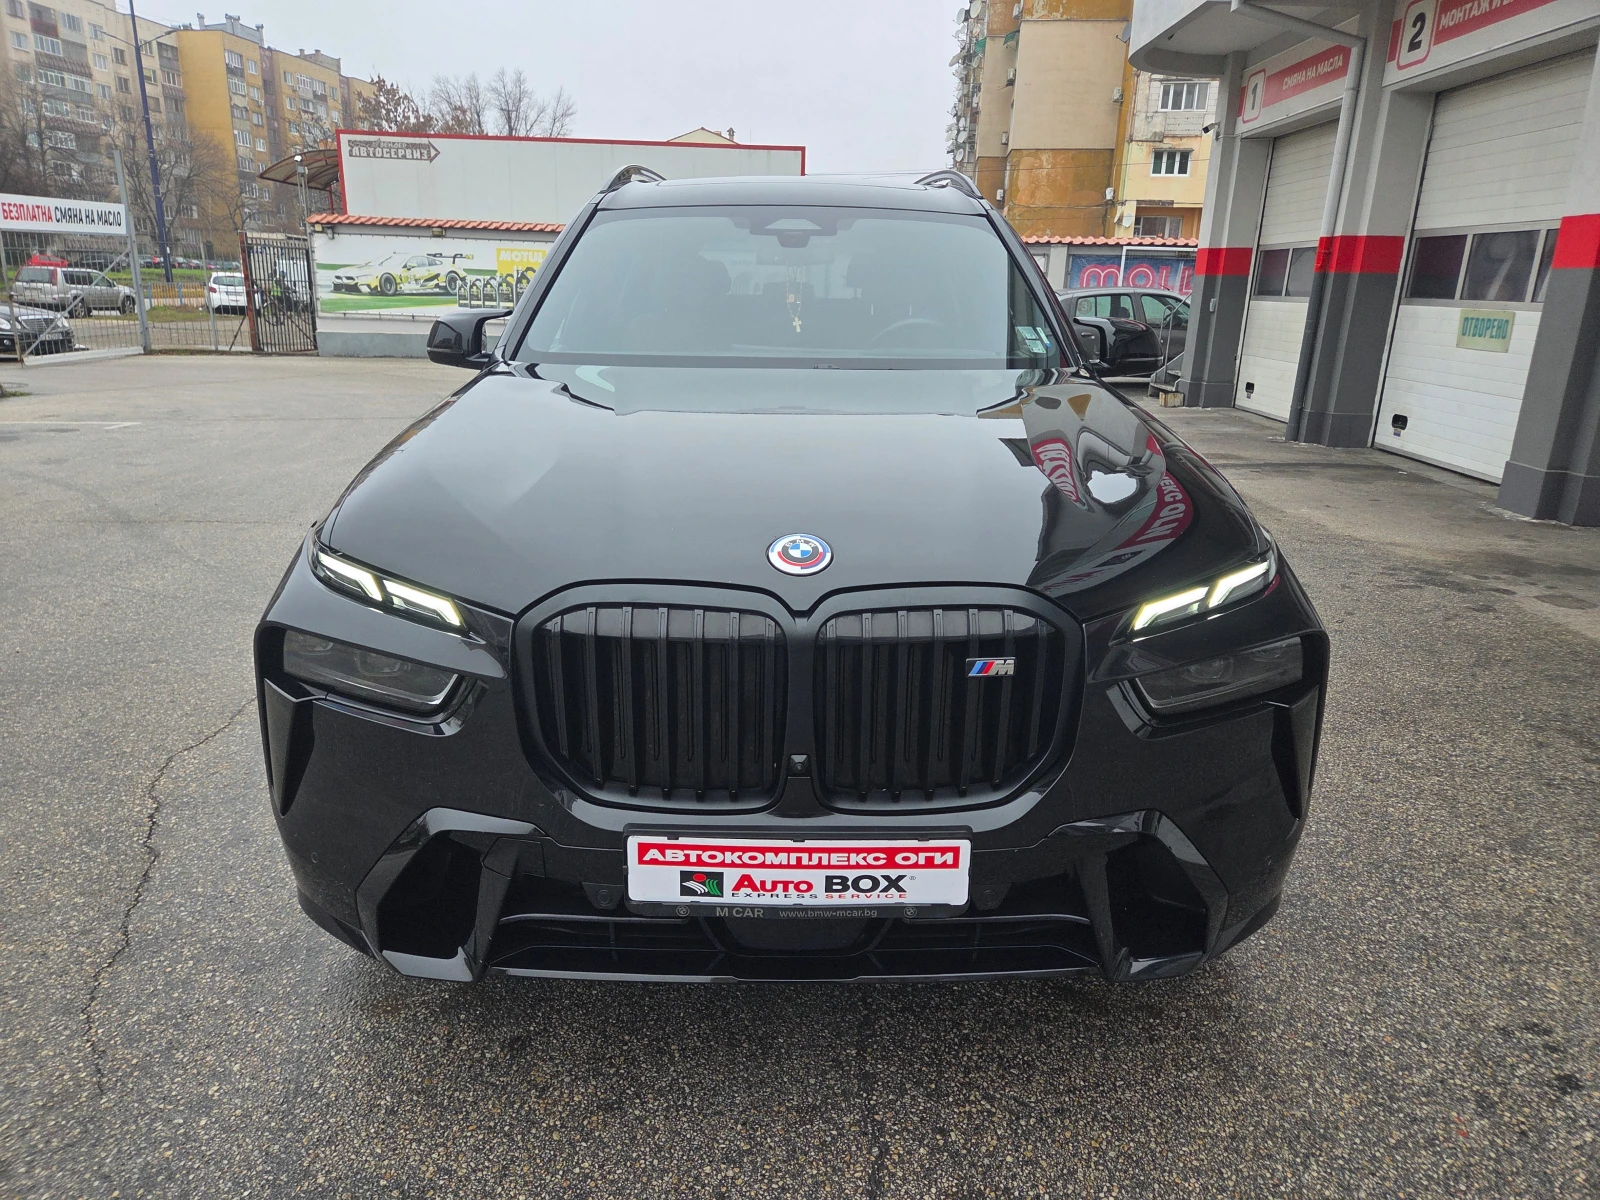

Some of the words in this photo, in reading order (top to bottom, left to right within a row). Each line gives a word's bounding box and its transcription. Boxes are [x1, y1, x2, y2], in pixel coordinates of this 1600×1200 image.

[1439, 0, 1490, 30] МОНТАЖ
[1407, 12, 1426, 53] 2
[1282, 70, 1306, 91] СМЯНА
[1306, 66, 1316, 81] НА
[1316, 53, 1344, 77] МАСЛА
[1251, 82, 1259, 111] 1
[352, 146, 429, 159] АВТОСЕРВИЗ
[1, 202, 53, 222] БЕЗПЛАТНА
[54, 206, 84, 224] СМЯНА
[85, 208, 96, 225] НА
[96, 209, 122, 227] МАСЛО
[500, 250, 543, 263] MOTUL
[1461, 316, 1510, 340] ОТВОРЕНО
[642, 848, 887, 866] АВТОКОМПЛЕКС
[894, 851, 954, 866] ОГИ
[825, 874, 908, 893] BOX
[716, 907, 729, 917] M
[732, 907, 764, 918] CAR
[779, 909, 878, 918] www.bmw-mcar.bg
